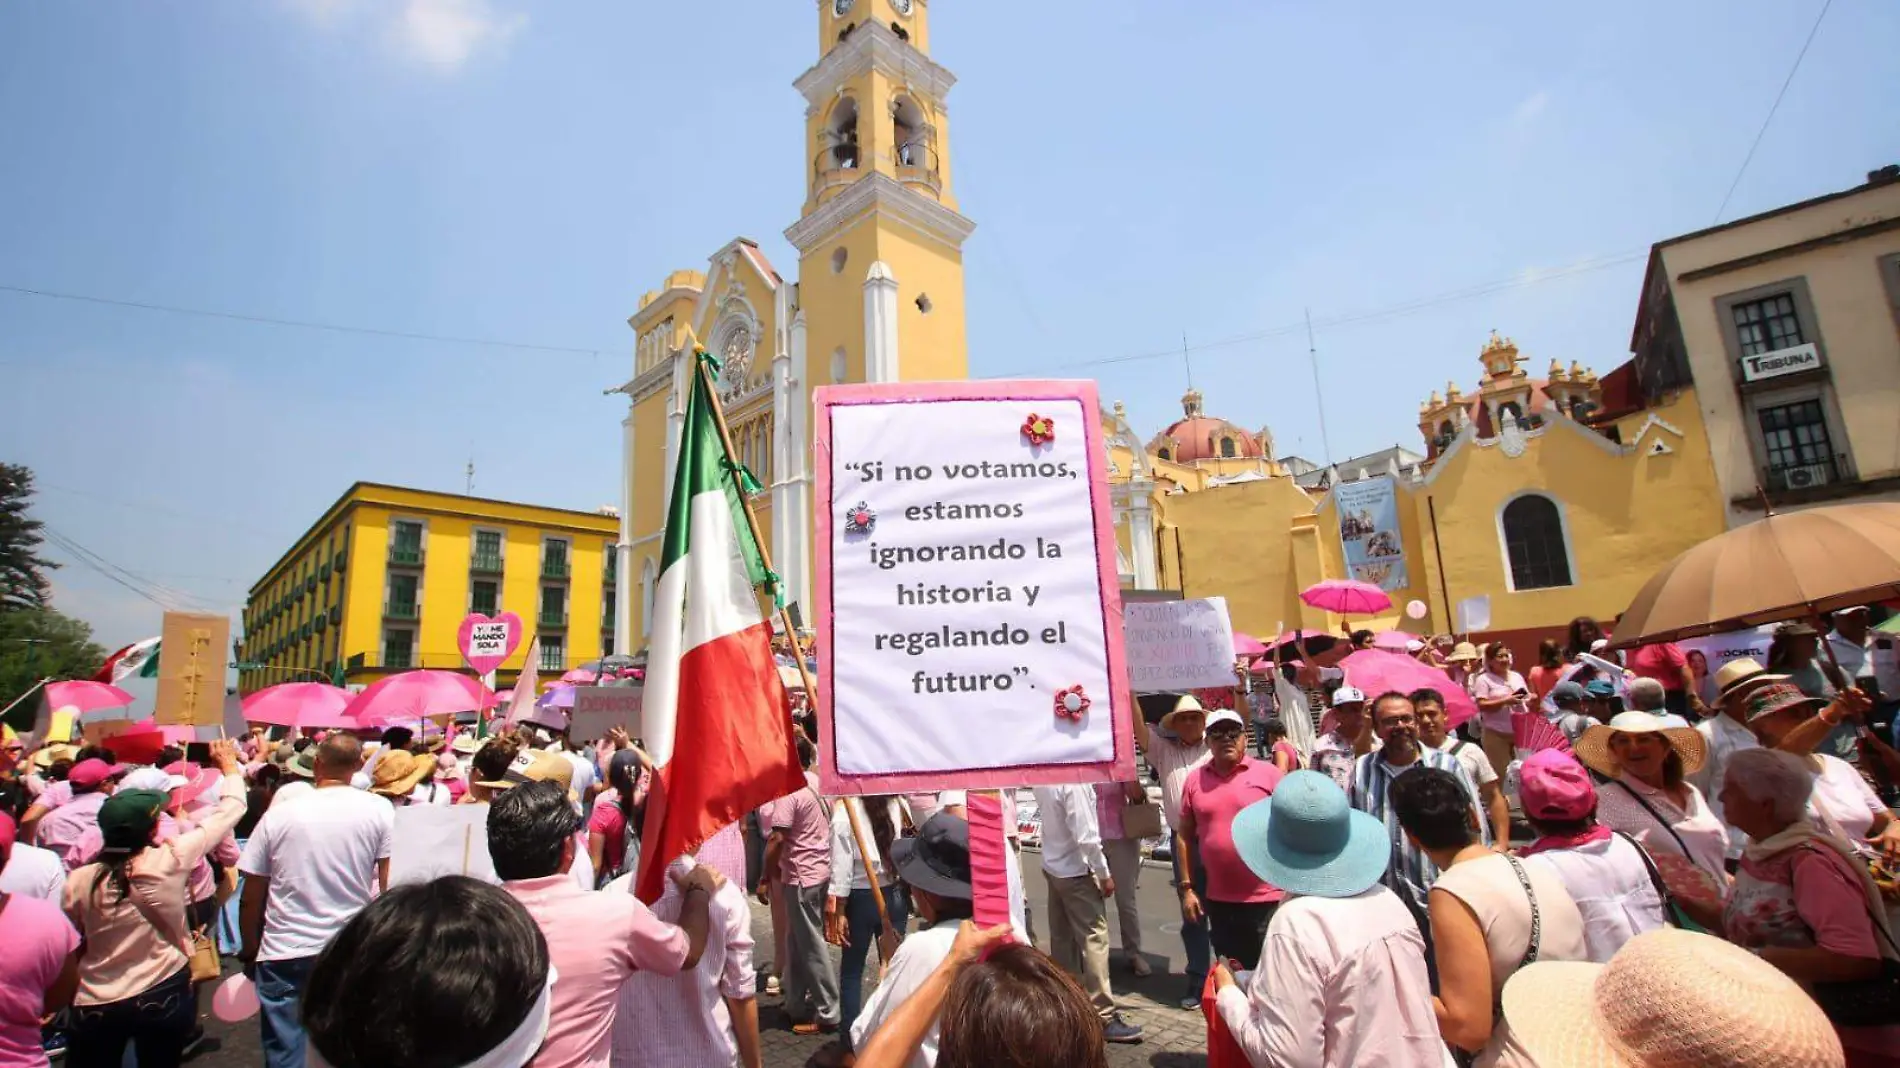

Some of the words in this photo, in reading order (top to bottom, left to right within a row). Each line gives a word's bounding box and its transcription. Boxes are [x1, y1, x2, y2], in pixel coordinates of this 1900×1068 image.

[1747, 352, 1815, 373] TRIBUNA
[895, 462, 932, 481] no
[942, 460, 1078, 482] votamos,
[905, 502, 1024, 521] estamos
[870, 537, 1026, 569] ignorando
[1036, 536, 1062, 559] la
[897, 581, 1011, 605] historia
[1023, 584, 1040, 607] y
[491, 624, 504, 632] ME
[874, 623, 1029, 655] regalando
[1040, 621, 1066, 645] el
[477, 641, 500, 649] SOLA
[912, 666, 1036, 694] futuro”.
